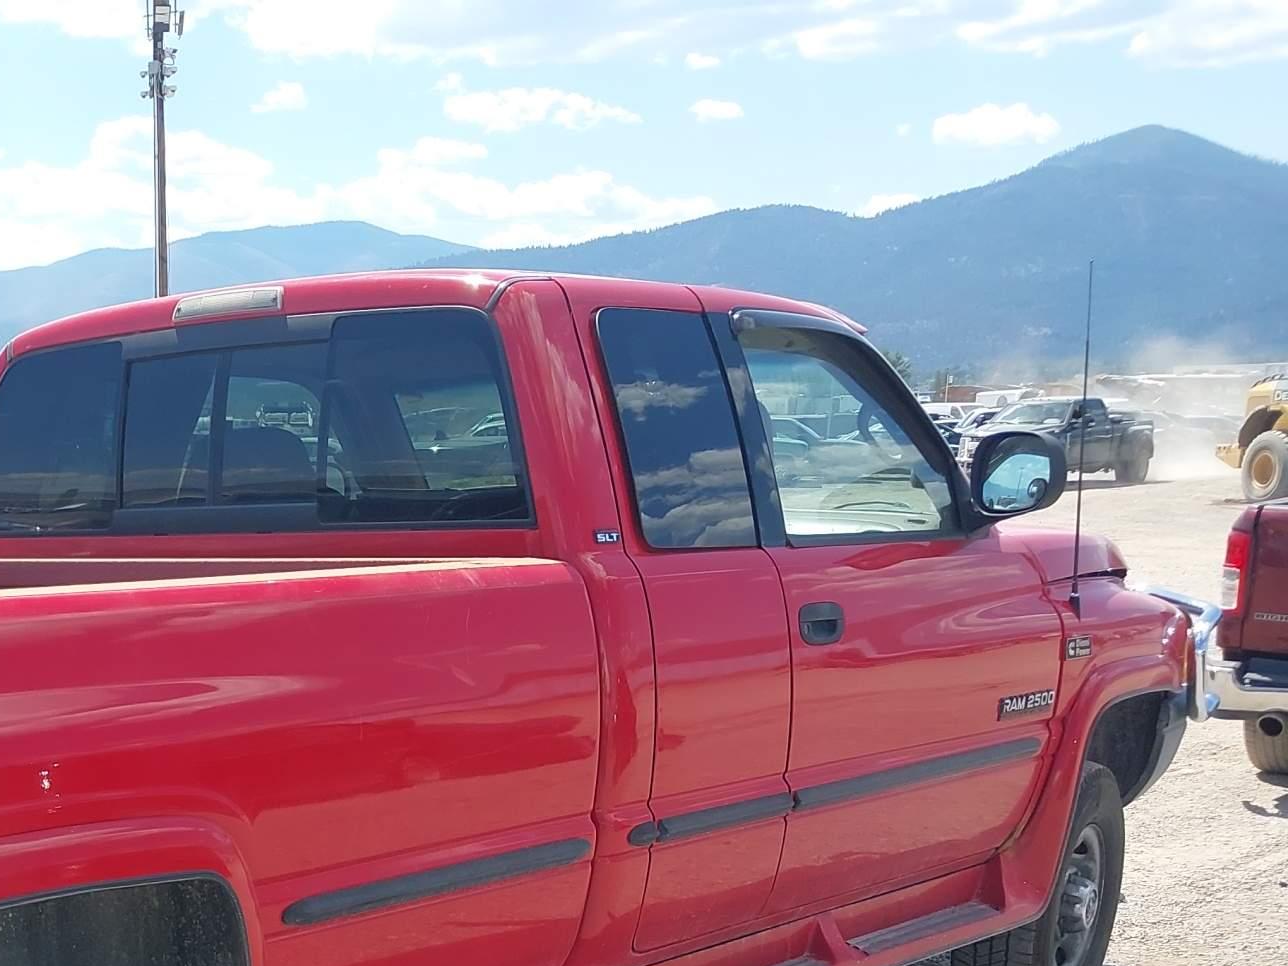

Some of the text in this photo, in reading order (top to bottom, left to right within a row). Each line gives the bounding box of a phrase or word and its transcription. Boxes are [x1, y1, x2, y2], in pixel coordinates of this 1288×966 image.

[596, 533, 619, 542] SLT
[1003, 691, 1055, 713] RAM 2500
